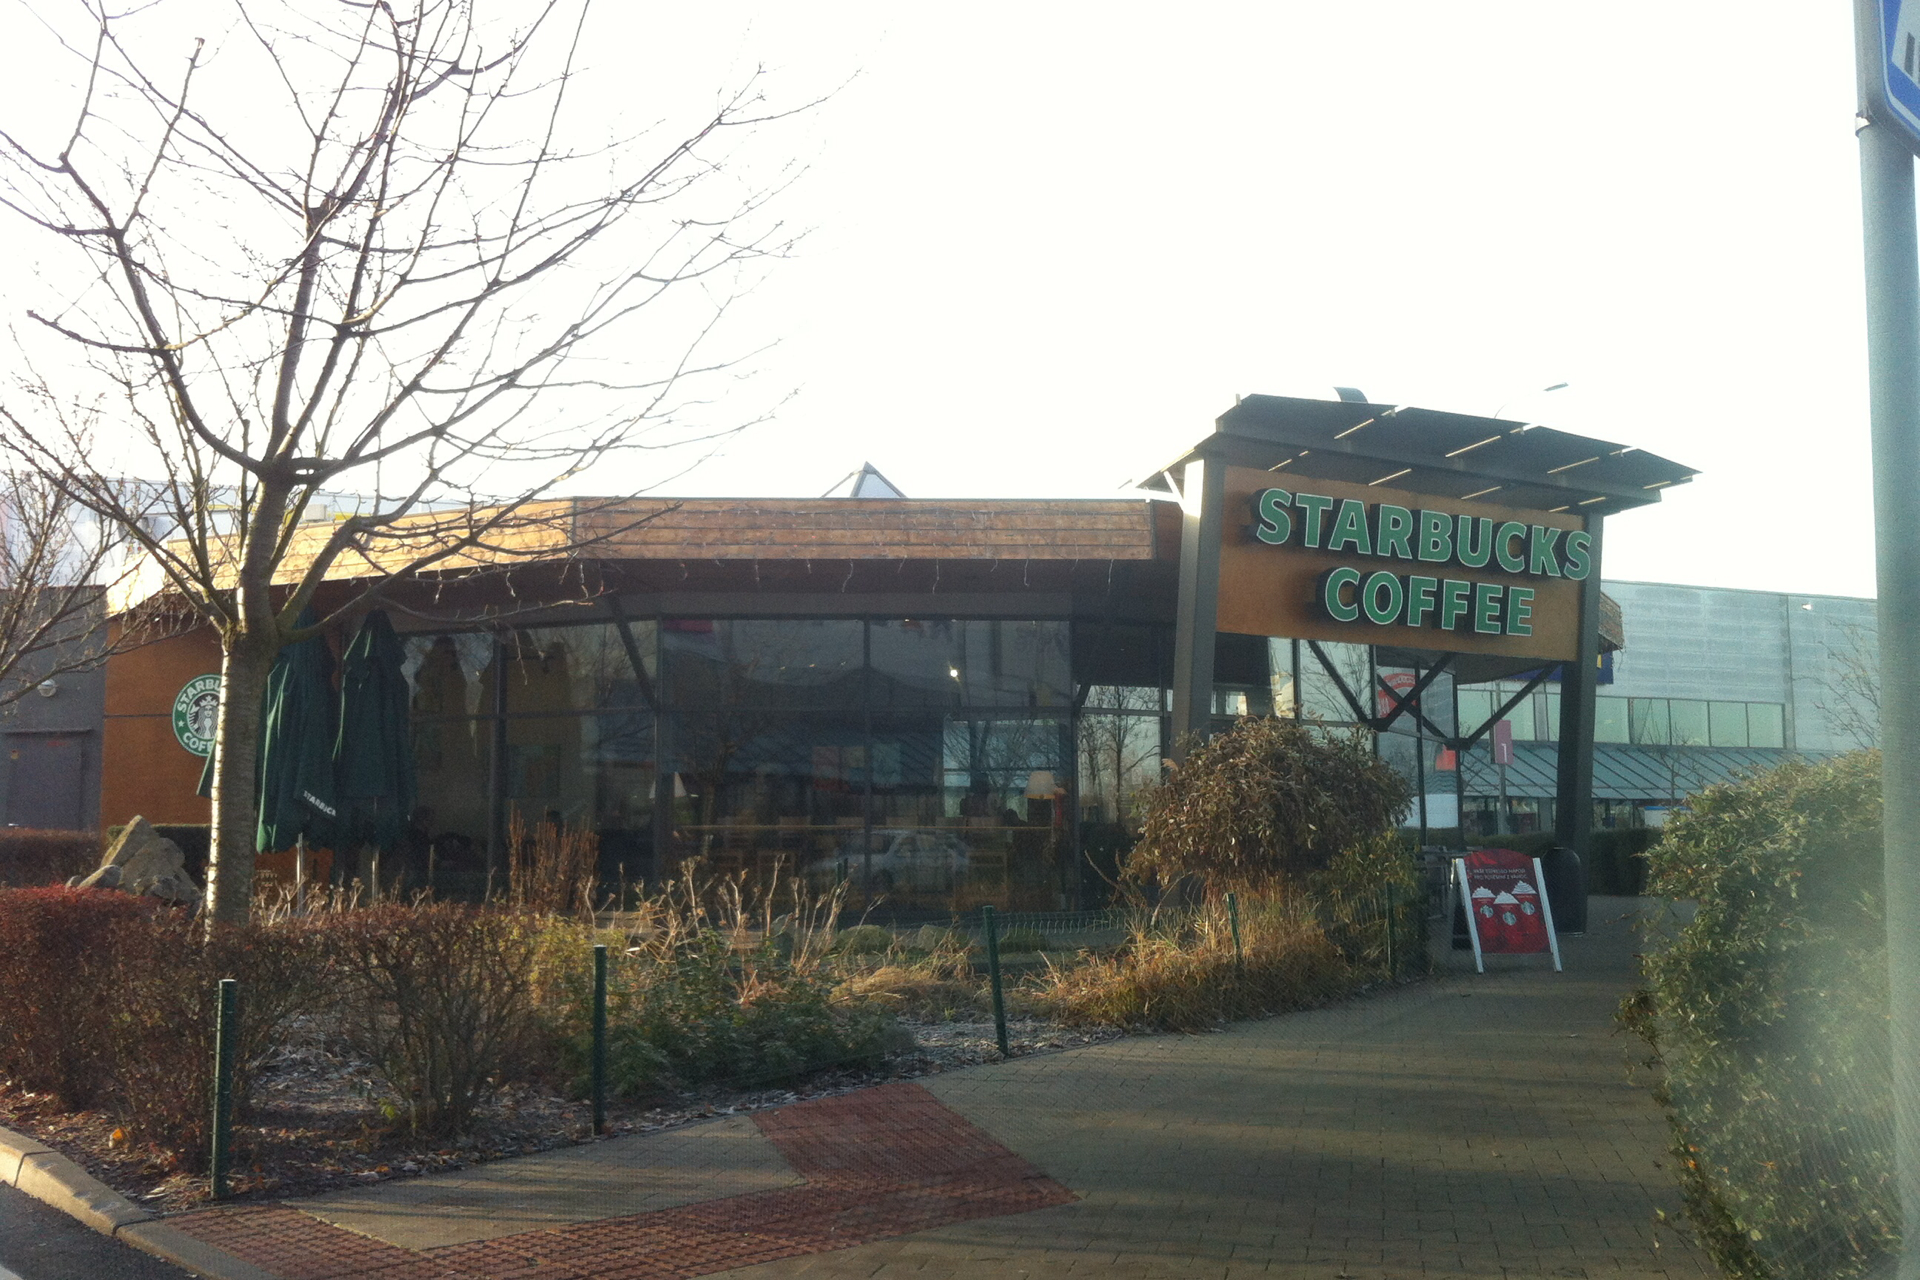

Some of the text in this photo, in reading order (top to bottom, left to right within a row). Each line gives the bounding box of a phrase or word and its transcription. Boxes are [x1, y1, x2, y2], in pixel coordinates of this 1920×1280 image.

[1256, 488, 1592, 580] STARBUCKS
[1325, 567, 1534, 637] COFFEE
[177, 679, 221, 713] STARBU
[183, 732, 214, 752] COFF
